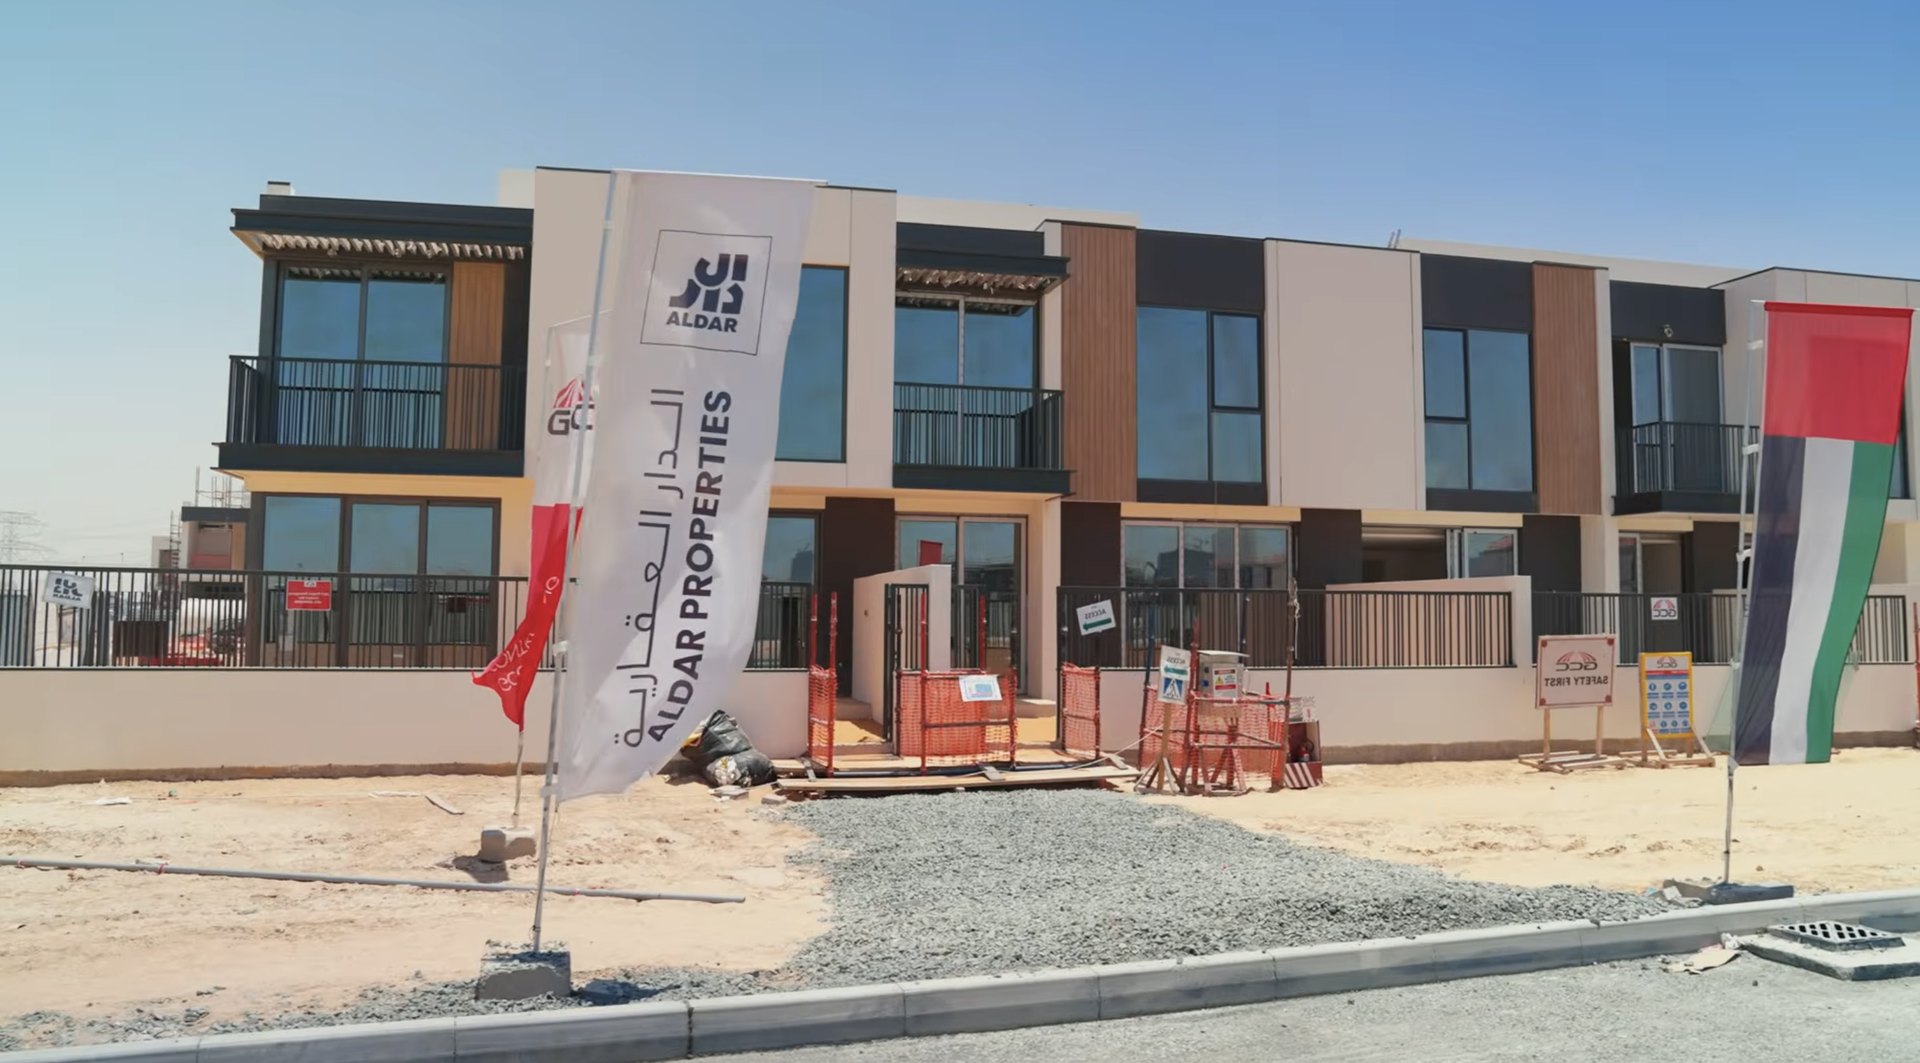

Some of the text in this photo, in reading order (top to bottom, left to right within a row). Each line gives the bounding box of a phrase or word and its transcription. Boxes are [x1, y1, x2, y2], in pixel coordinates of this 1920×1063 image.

[666, 311, 738, 333] ALDAR
[548, 404, 596, 435] GC
[614, 389, 684, 747] الدار العقارية
[648, 390, 731, 742] ALDAR PROPERTIES
